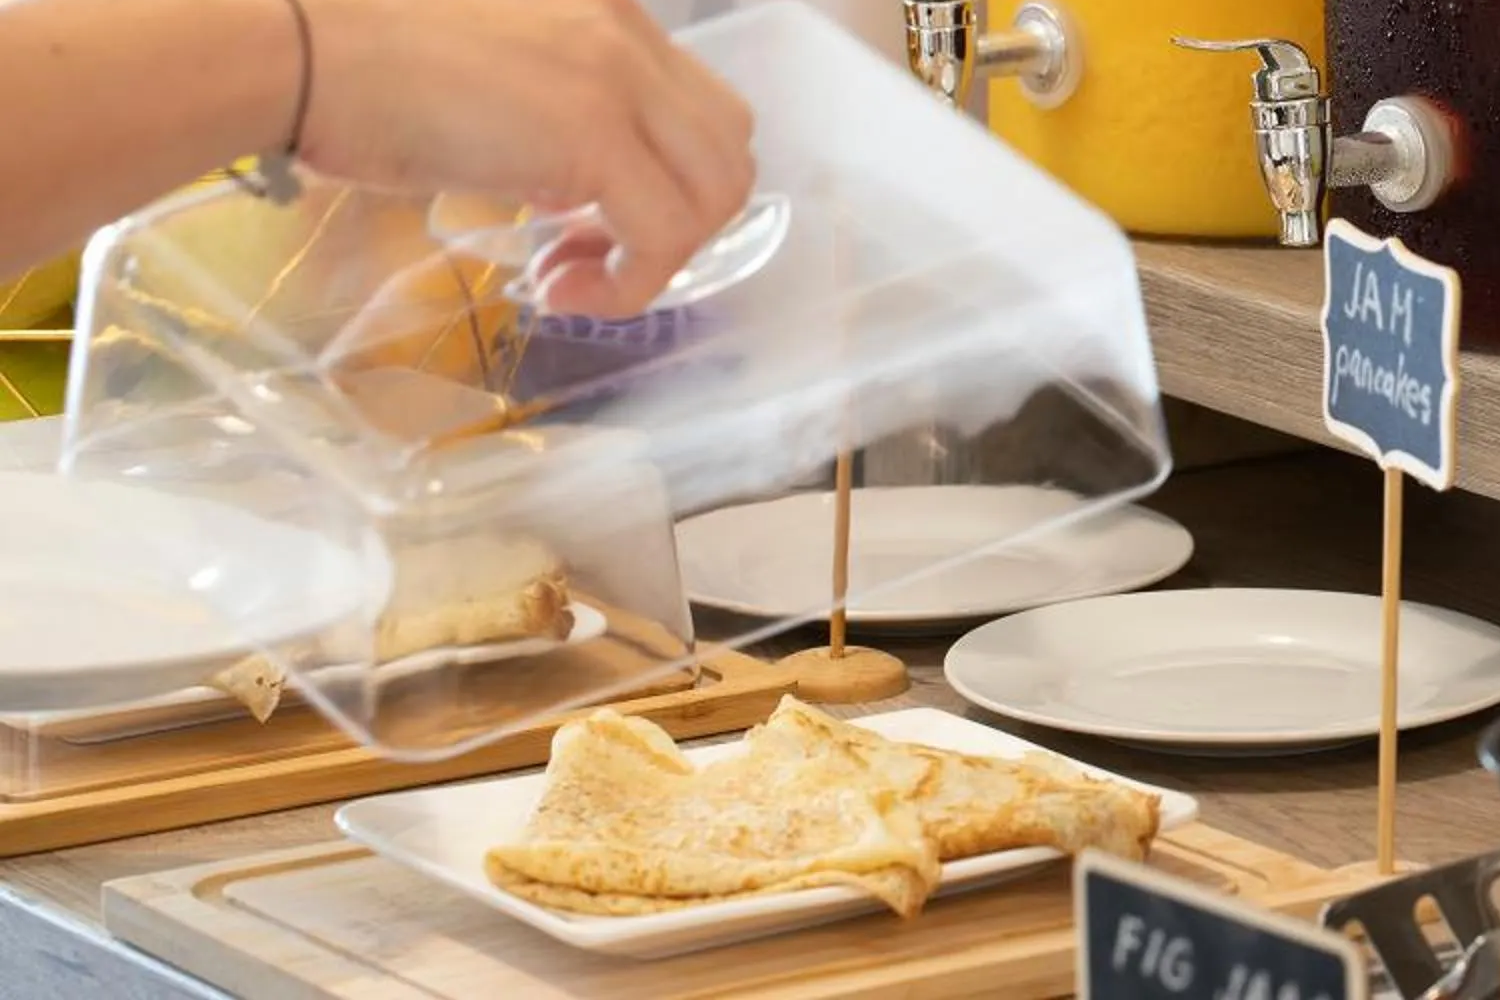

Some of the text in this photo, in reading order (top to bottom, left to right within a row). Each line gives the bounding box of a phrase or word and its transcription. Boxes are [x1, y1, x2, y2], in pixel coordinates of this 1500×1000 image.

[1344, 262, 1413, 345] JAM
[1331, 344, 1431, 425] pancakes
[1111, 913, 1194, 992] FIG
